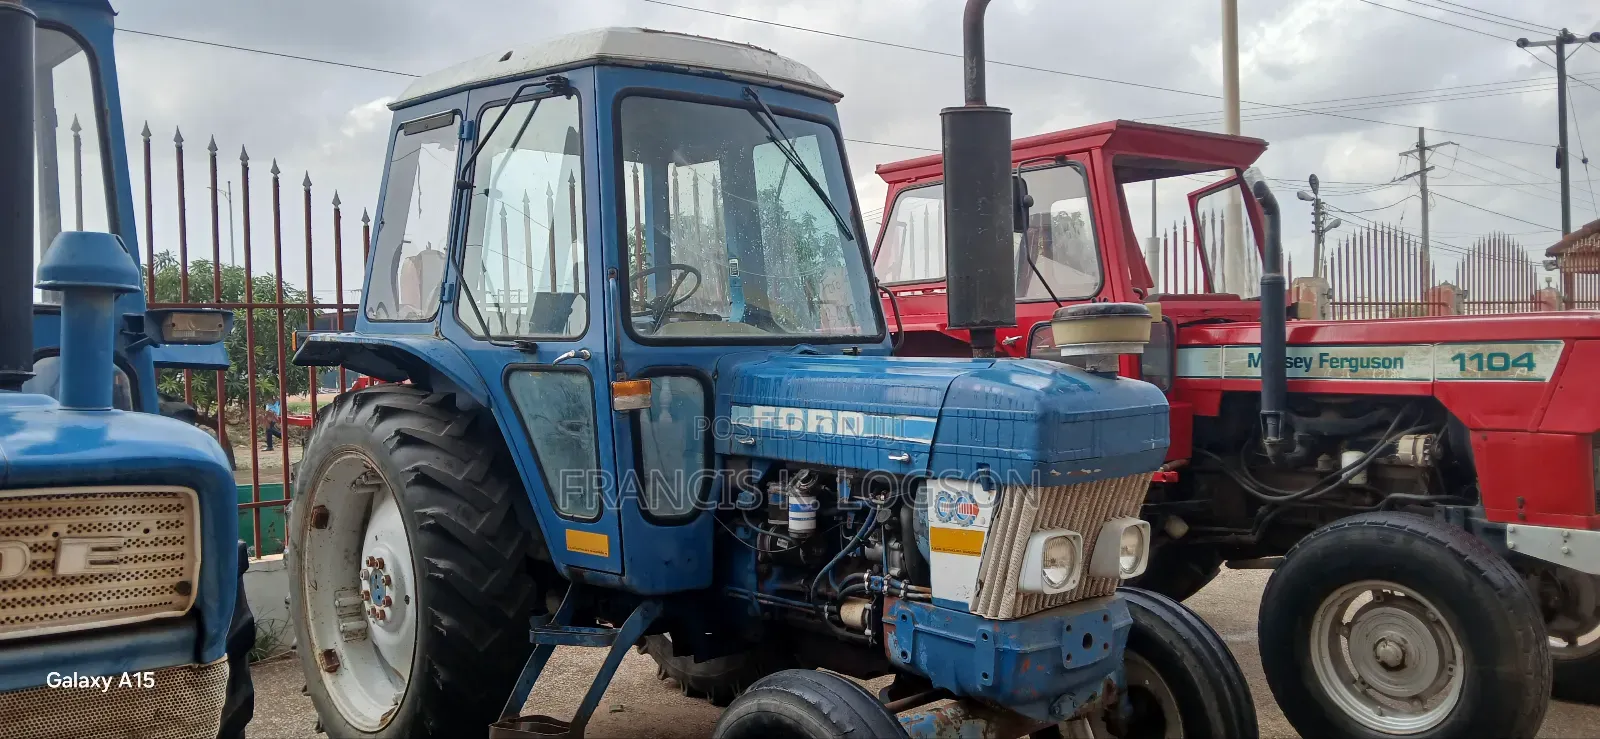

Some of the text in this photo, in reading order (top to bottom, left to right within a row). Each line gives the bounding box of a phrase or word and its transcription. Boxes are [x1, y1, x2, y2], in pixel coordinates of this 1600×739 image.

[1248, 352, 1404, 373] Msey Ferguson
[1451, 352, 1536, 372] 1104
[753, 405, 864, 436] FORD
